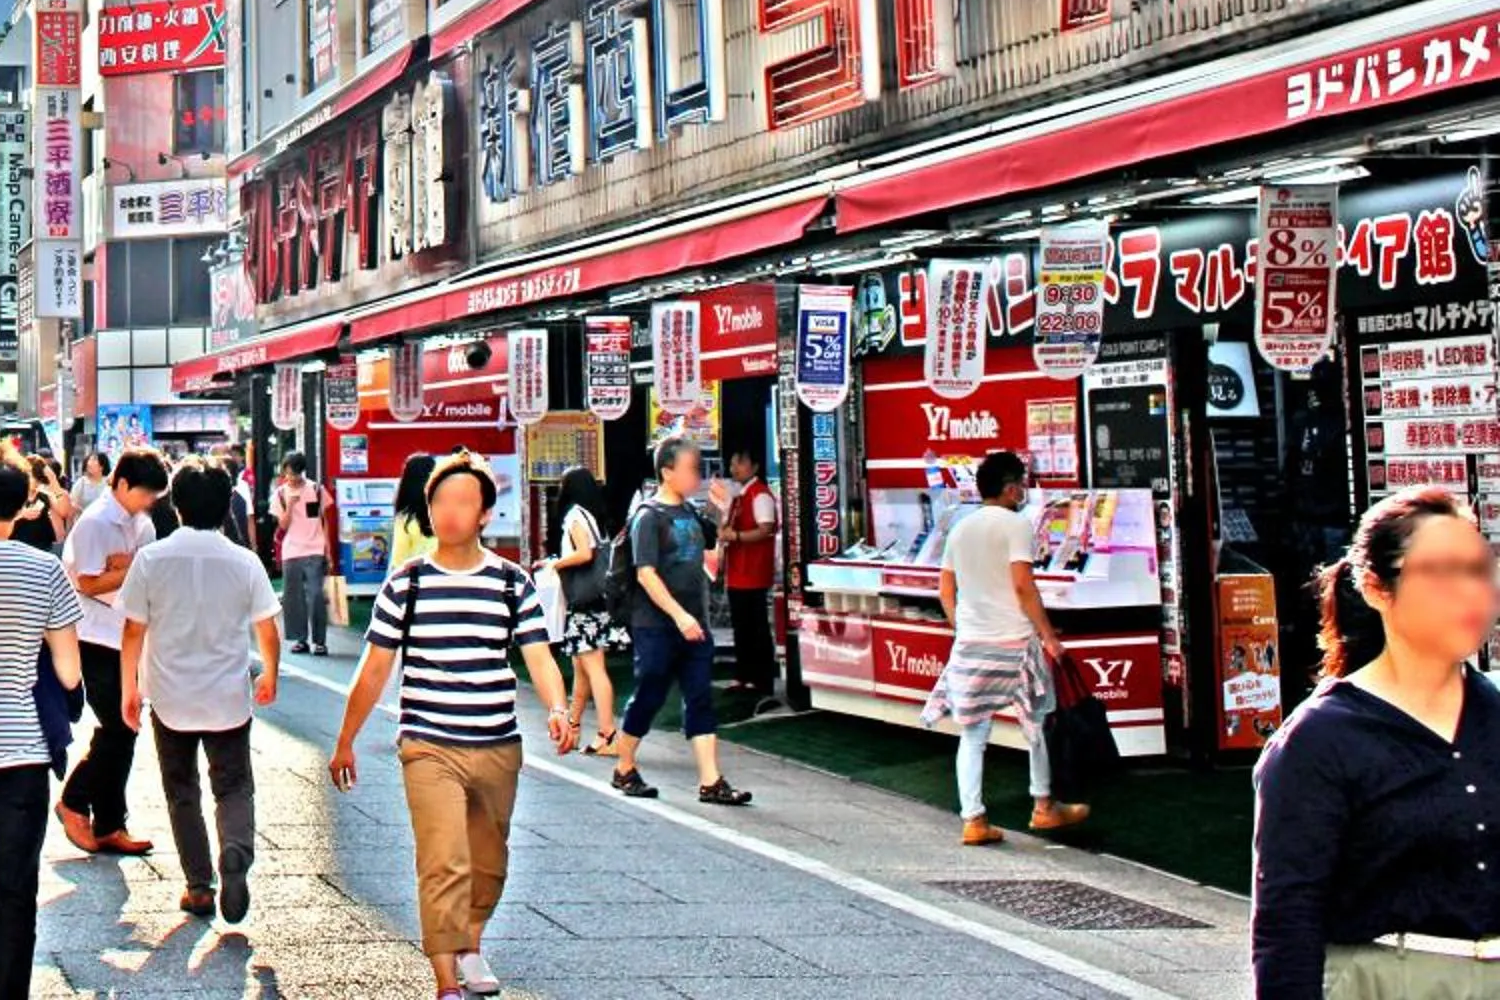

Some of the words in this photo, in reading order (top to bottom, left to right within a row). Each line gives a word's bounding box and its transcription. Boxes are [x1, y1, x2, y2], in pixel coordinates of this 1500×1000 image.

[1287, 24, 1500, 120] ヨドバシカメ
[8, 152, 25, 197] Map
[1266, 229, 1327, 267] 8%
